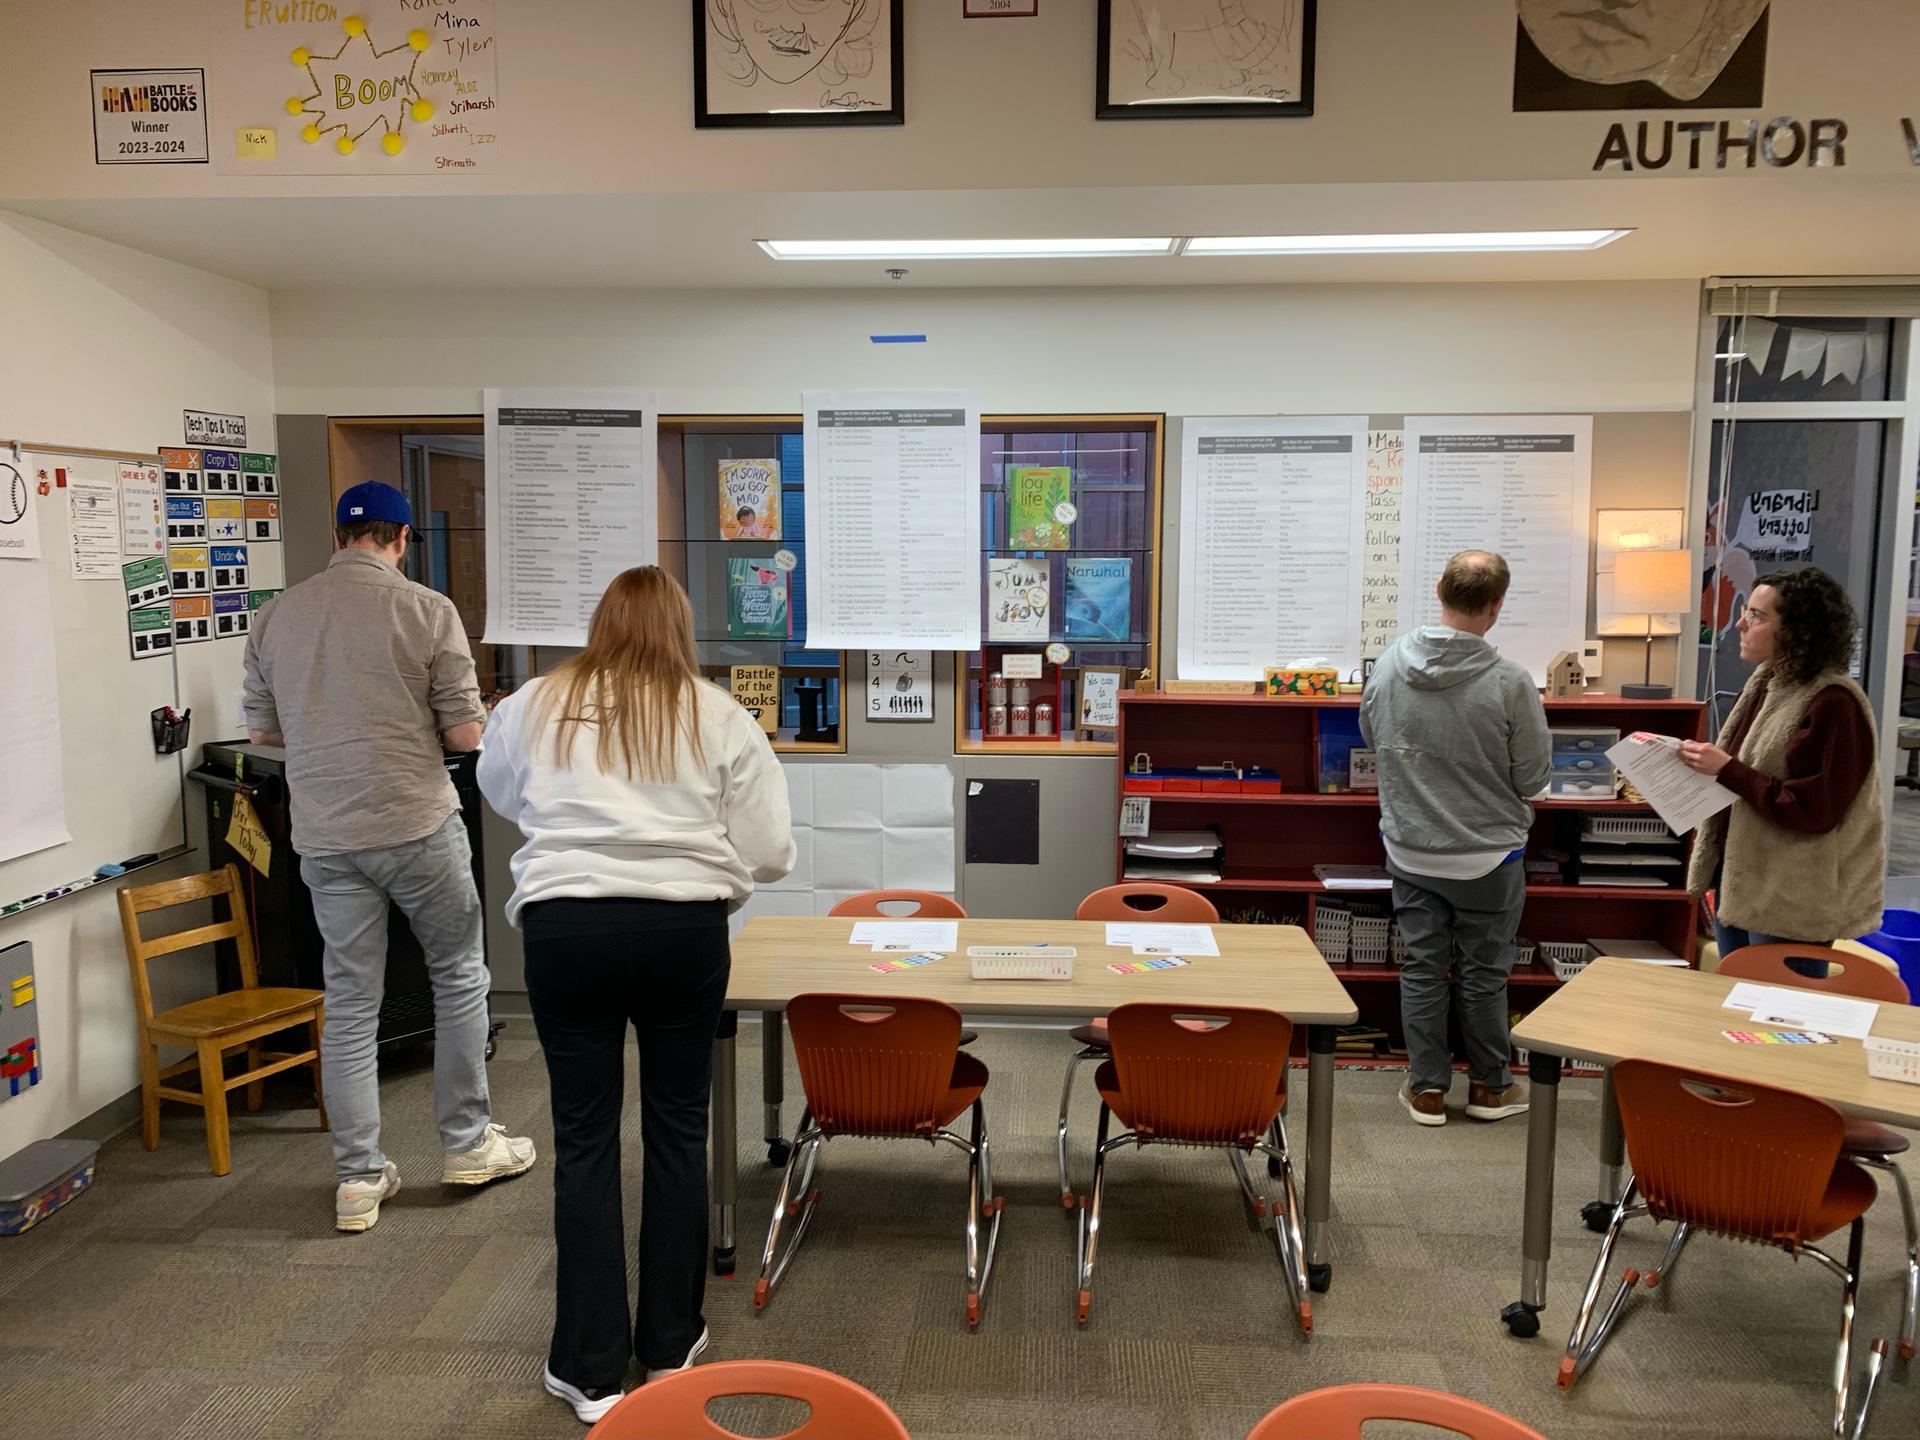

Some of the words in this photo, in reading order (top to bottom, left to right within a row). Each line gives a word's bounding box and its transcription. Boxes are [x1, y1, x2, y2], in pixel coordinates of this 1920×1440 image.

[989, 0, 1011, 10] 2004
[434, 11, 480, 29] Mina
[443, 36, 493, 62] Tyler
[149, 85, 186, 96] BATTLE
[334, 74, 411, 110] BOOM
[150, 97, 197, 112] BOOKS
[450, 97, 495, 115] Sriharsh
[131, 121, 170, 133] Winner
[245, 133, 267, 144] Nick
[1592, 116, 1848, 172] AUTHOR
[119, 141, 185, 154] 2023-2024
[186, 415, 203, 431] Tech
[204, 417, 218, 436] Tips
[219, 419, 225, 433] &
[206, 453, 226, 468] Copy
[244, 457, 264, 468] Paste
[740, 467, 771, 483] SORRY
[726, 483, 745, 496] YOU
[748, 481, 769, 494] GOT
[1021, 475, 1043, 492] log
[736, 494, 760, 506] MAD
[1021, 491, 1042, 506] life
[1366, 492, 1396, 508] lass
[214, 549, 235, 561] Undo
[1067, 566, 1126, 579] Narwhal
[741, 586, 769, 602] Teeny
[742, 599, 772, 615] Weeny
[1376, 619, 1398, 629] are
[871, 653, 881, 667] 3
[736, 668, 776, 680] Battle
[737, 681, 751, 692] of
[753, 681, 773, 691] the
[871, 676, 881, 689] 4
[734, 693, 777, 707] Books
[872, 698, 881, 711] 5
